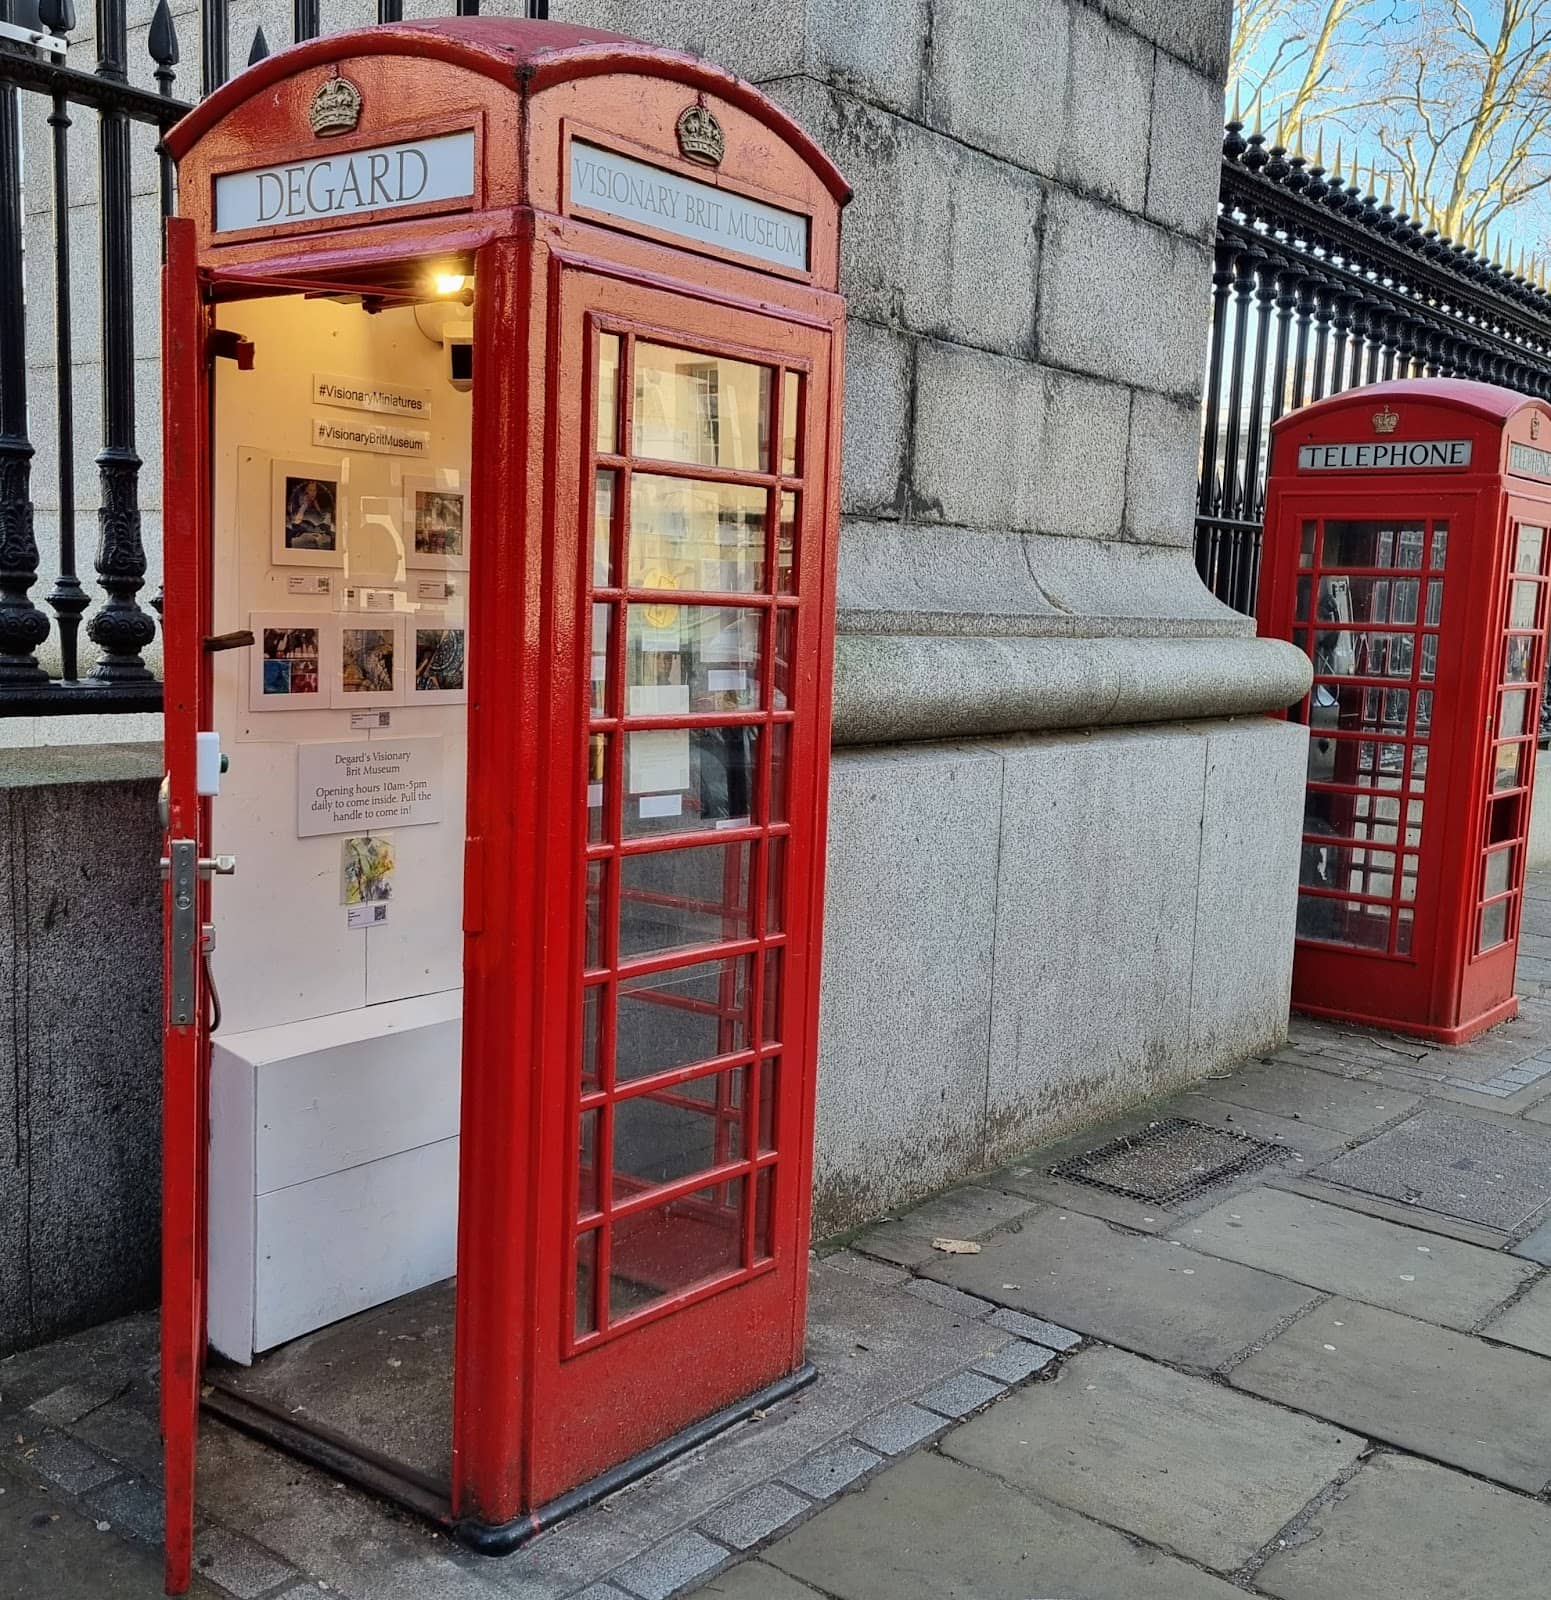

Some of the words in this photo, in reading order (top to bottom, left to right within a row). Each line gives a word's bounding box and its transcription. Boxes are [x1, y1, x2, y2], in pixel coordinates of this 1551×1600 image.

[256, 149, 428, 222] DEGARD
[574, 158, 680, 219] VISIONARY
[685, 196, 723, 231] BRIT
[727, 207, 802, 257] MUSEUM
[319, 384, 423, 410] #VisionaryMiniatures
[319, 426, 423, 450] #VisionaryBritMuseum
[1306, 443, 1465, 467] TELEPHONE
[335, 753, 371, 765] Degard's
[373, 751, 411, 762] Visionary
[346, 767, 361, 777] Brit
[363, 765, 400, 775] Museum
[316, 784, 354, 798] Opening
[356, 782, 380, 793] hours
[383, 780, 427, 792] 10am-5pm
[311, 797, 332, 811] daily
[335, 798, 344, 808] to
[346, 796, 370, 807] come
[401, 792, 417, 802] Pull
[418, 791, 432, 801] the
[333, 809, 363, 822] handle
[365, 810, 374, 819] to
[376, 808, 399, 818] come
[400, 805, 412, 816] in!
